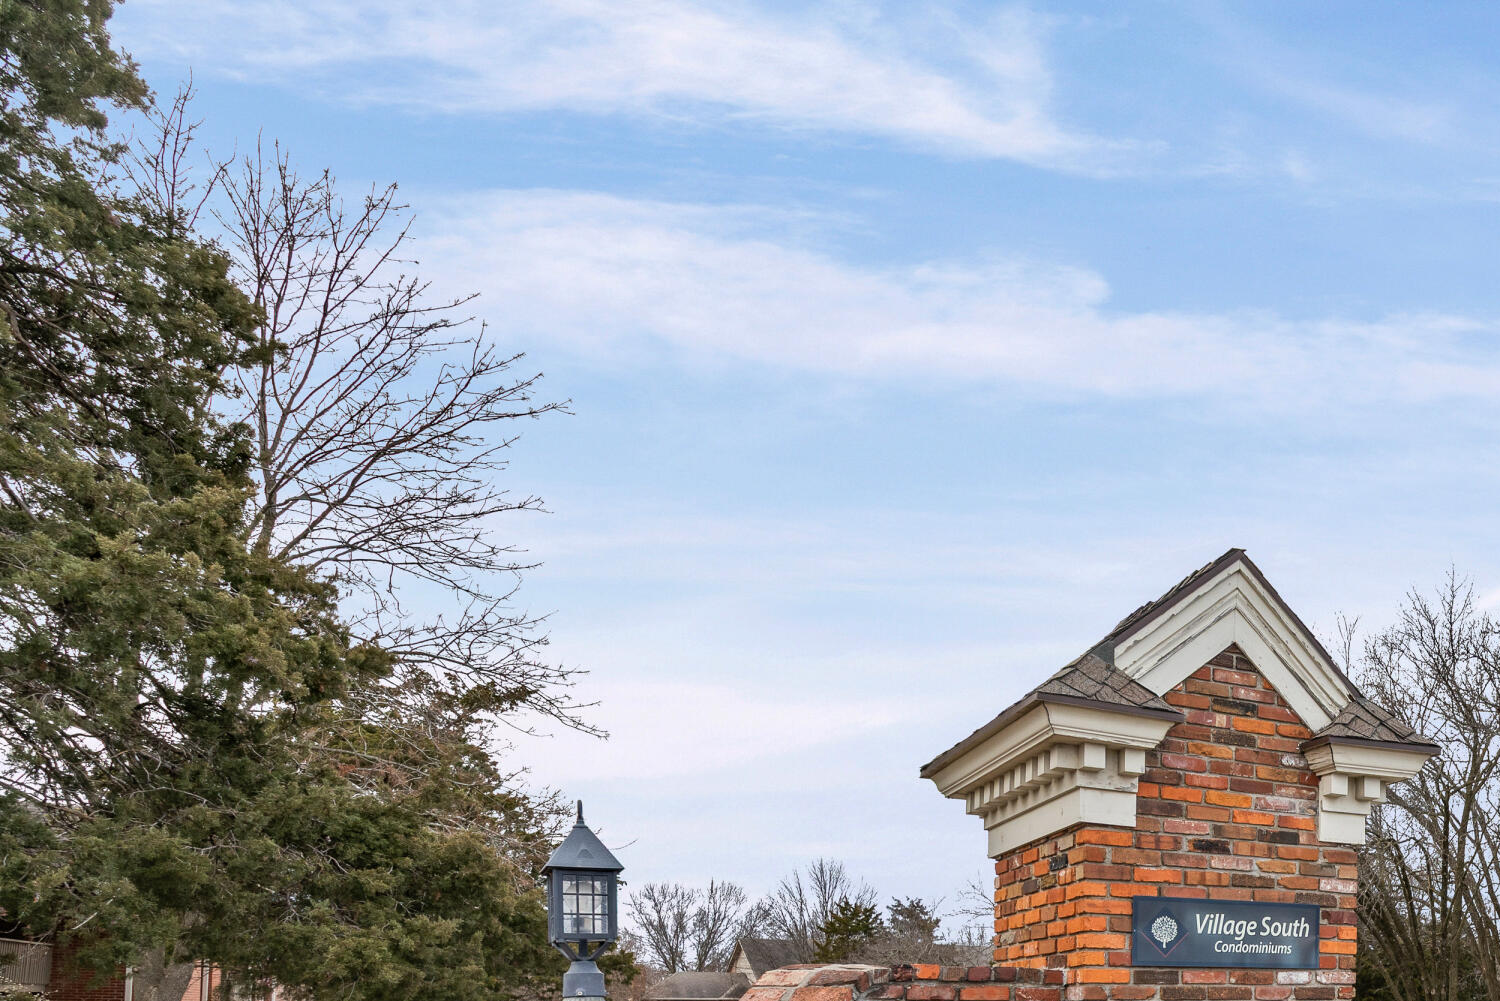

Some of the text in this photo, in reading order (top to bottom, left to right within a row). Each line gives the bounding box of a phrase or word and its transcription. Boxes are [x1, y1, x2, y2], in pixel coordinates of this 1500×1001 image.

[1195, 914, 1310, 940] Village South
[1214, 940, 1292, 954] Condominiums
